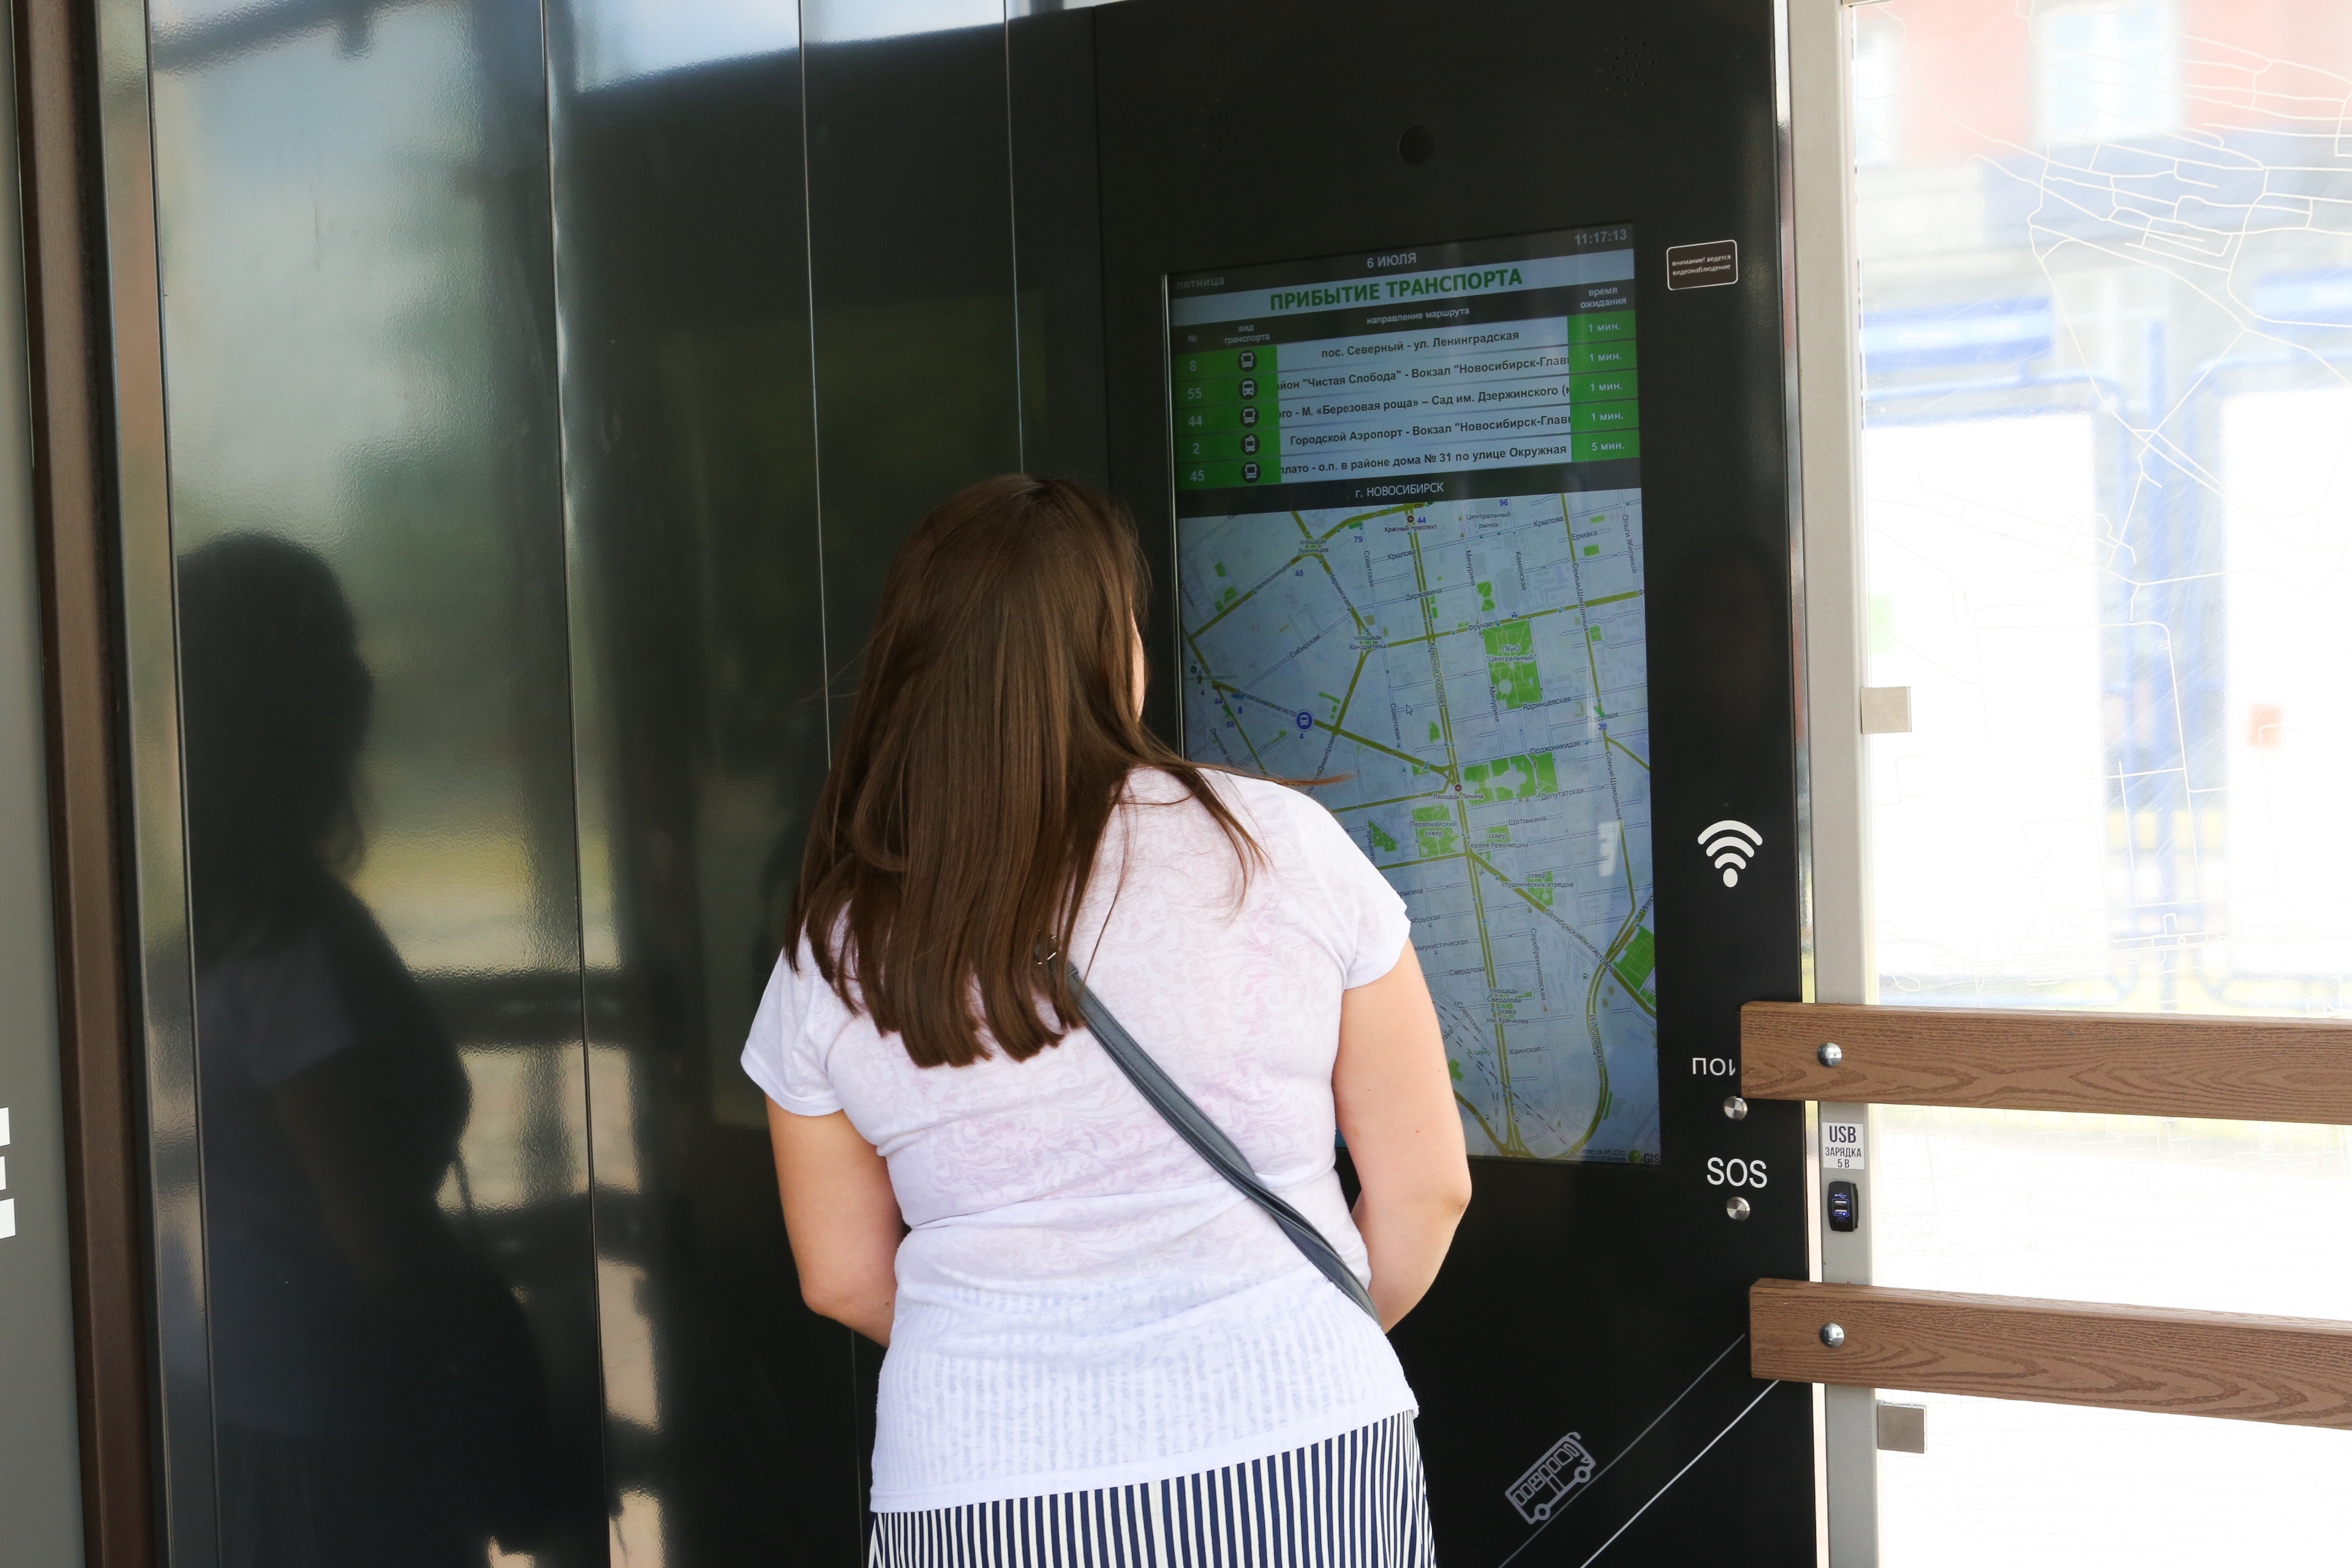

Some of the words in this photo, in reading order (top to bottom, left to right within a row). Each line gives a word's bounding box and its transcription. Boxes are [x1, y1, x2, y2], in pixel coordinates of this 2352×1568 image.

[1575, 229, 1627, 246] 11:17:13
[1366, 258, 1374, 268] 6
[1378, 252, 1417, 267] ИЮЛЯ
[1672, 257, 1705, 267] внимание!
[1707, 254, 1732, 263] ведется
[1672, 263, 1731, 276] видеонаблюдение
[1177, 276, 1225, 290] пятница
[1270, 282, 1380, 311] ПРИБЫТИЕ
[1385, 268, 1523, 298] ТРАНСПОРТА
[1588, 287, 1618, 298] время
[1580, 297, 1627, 309] ожидания
[1366, 312, 1423, 325] направление
[1425, 307, 1470, 318] маршрута
[1588, 323, 1593, 332] 1
[1597, 323, 1621, 331] мин.
[1224, 333, 1270, 345] транспорта
[1321, 349, 1344, 358] пос.
[1348, 341, 1404, 356] Северный
[1414, 342, 1429, 352] ул.
[1433, 331, 1519, 348] Ленинградская
[1589, 353, 1594, 362] 1
[1597, 353, 1622, 361] мин.
[1189, 360, 1197, 372] 8
[1302, 376, 1346, 388] "Чистая
[1349, 370, 1401, 385] Слобода"
[1411, 368, 1451, 378] Вокзал
[1188, 387, 1202, 399] 55
[1590, 383, 1595, 391] 1
[1599, 383, 1623, 391] мин.
[1302, 407, 1313, 416] М.
[1316, 402, 1381, 416] «Березовая
[1384, 399, 1419, 412] роща»
[1431, 394, 1453, 406] Сад
[1456, 394, 1474, 403] им.
[1478, 386, 1558, 403] Дзержинского
[1188, 415, 1203, 427] 44
[1591, 413, 1596, 421] 1
[1600, 413, 1624, 421] мин.
[1290, 431, 1346, 446] Городской
[1349, 428, 1403, 442] Аэропорт
[1412, 424, 1452, 435] Вокзал
[1193, 443, 1200, 454] 2
[1592, 442, 1598, 451] 5
[1600, 442, 1625, 451] мин.
[1318, 463, 1338, 472] о.п.
[1351, 458, 1390, 471] районе
[1393, 456, 1421, 467] дома
[1424, 454, 1436, 463] №
[1439, 453, 1452, 462] 31
[1456, 453, 1469, 461] по
[1472, 450, 1506, 462] улице
[1509, 445, 1567, 458] Окружная
[1190, 470, 1205, 481] 45
[1367, 482, 1444, 497] НОВОСИБИРСК
[1466, 511, 1511, 521] Центральный
[1533, 516, 1564, 527] Крылова
[1410, 524, 1438, 532] проспект
[1479, 522, 1499, 530] рынок
[1572, 530, 1598, 541] Ермака
[1387, 549, 1416, 560] Крылова
[1363, 550, 1375, 588] Советская
[1465, 549, 1476, 586] Мичурина
[1515, 551, 1527, 591] Каменская
[1329, 571, 1351, 608] Нарымская
[1406, 587, 1442, 601] Державина
[1468, 621, 1494, 631] Фрунзе
[1289, 634, 1321, 658] Сибирская
[1488, 686, 1500, 723] Мичурина
[1523, 697, 1572, 710] Ядринцевская
[1390, 703, 1401, 741] Советская
[1530, 740, 1581, 755] Орджоникидзе
[1541, 788, 1585, 802] Депутатская
[1509, 816, 1547, 826] Щетинкина
[1545, 908, 1586, 941] Октябрьская
[1584, 939, 1615, 974] магистраль
[1449, 967, 1486, 976] Свердлова
[1457, 1001, 1482, 1034] Советская
[1509, 1046, 1542, 1055] Каинская
[1829, 1125, 1856, 1144] USB
[1825, 1147, 1862, 1158] ЗАРЯДКА
[1838, 1159, 1843, 1167] 5
[1845, 1159, 1850, 1168] В
[1706, 1157, 1768, 1188] SOS
